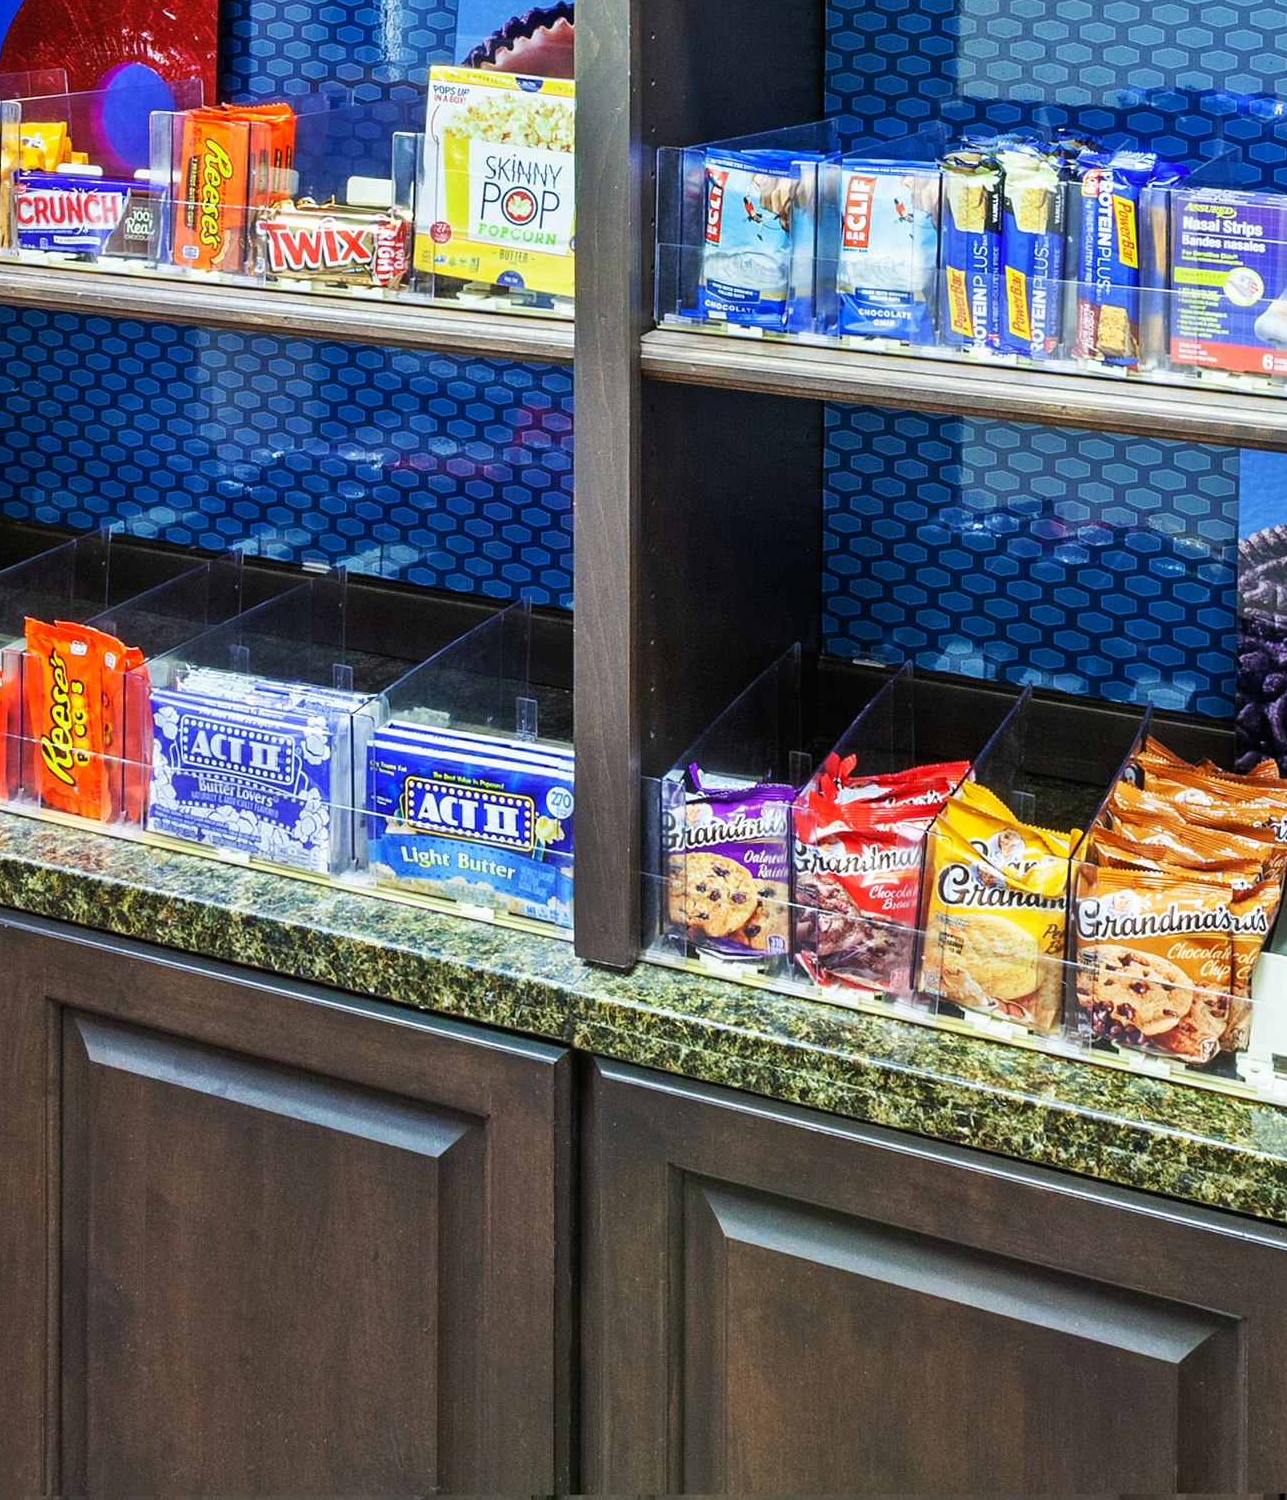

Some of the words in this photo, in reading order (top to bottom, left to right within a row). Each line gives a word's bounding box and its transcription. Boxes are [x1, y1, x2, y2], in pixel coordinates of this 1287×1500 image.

[433, 85, 456, 96] POPS
[484, 152, 563, 189] SKINNY
[200, 138, 234, 250] Reese's
[480, 181, 561, 229] POP
[846, 179, 871, 232] CLIF
[992, 193, 1000, 224] VANILLA
[16, 194, 119, 225] CRUNCH
[1054, 195, 1062, 225] VANILLA
[124, 217, 155, 236] Real
[477, 223, 558, 247] POPCORN
[846, 231, 866, 242] BAR
[1118, 201, 1135, 263] PowerBar
[1182, 216, 1220, 232] Nasal
[1223, 218, 1263, 237] Strips
[499, 249, 529, 263] BUTTER
[1182, 234, 1222, 248] Bandes
[1224, 238, 1266, 253] nasales
[858, 308, 912, 320] CHOCOLATE
[872, 318, 896, 328] CHIP
[1261, 353, 1274, 371] 6
[41, 650, 75, 785] Reese's
[190, 730, 246, 764] ACT
[249, 741, 282, 773] II
[198, 776, 236, 798] Butter
[236, 785, 274, 808] Lovers
[551, 791, 573, 809] 270
[417, 791, 479, 830] ACT
[482, 802, 520, 838] II
[401, 846, 451, 869] Light
[457, 851, 517, 880] Butter
[1077, 900, 1231, 940] Grandma's
[1199, 959, 1232, 982] Chip
